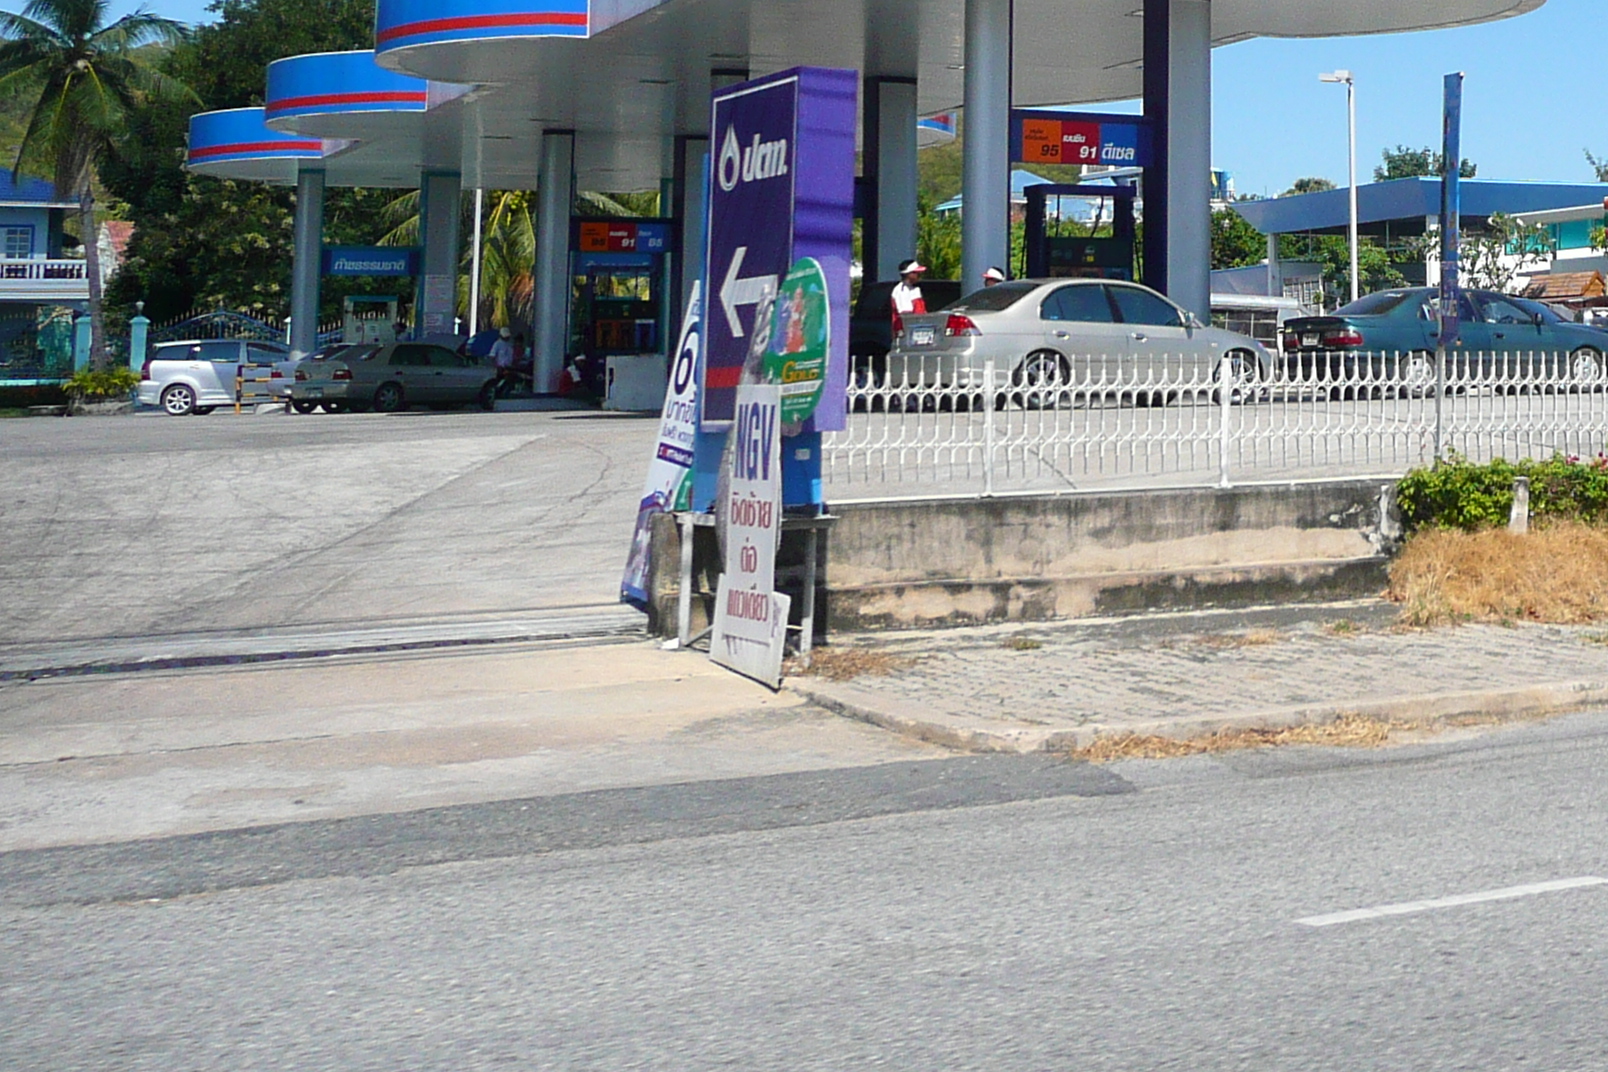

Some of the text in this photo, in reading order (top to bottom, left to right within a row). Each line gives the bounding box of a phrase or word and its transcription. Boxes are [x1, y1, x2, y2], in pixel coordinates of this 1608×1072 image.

[1040, 144, 1060, 157] 95
[1079, 146, 1097, 159] 91
[1101, 142, 1135, 160] ดีเซล
[621, 238, 636, 247] 91
[674, 320, 698, 396] 6
[734, 402, 776, 481] NGV
